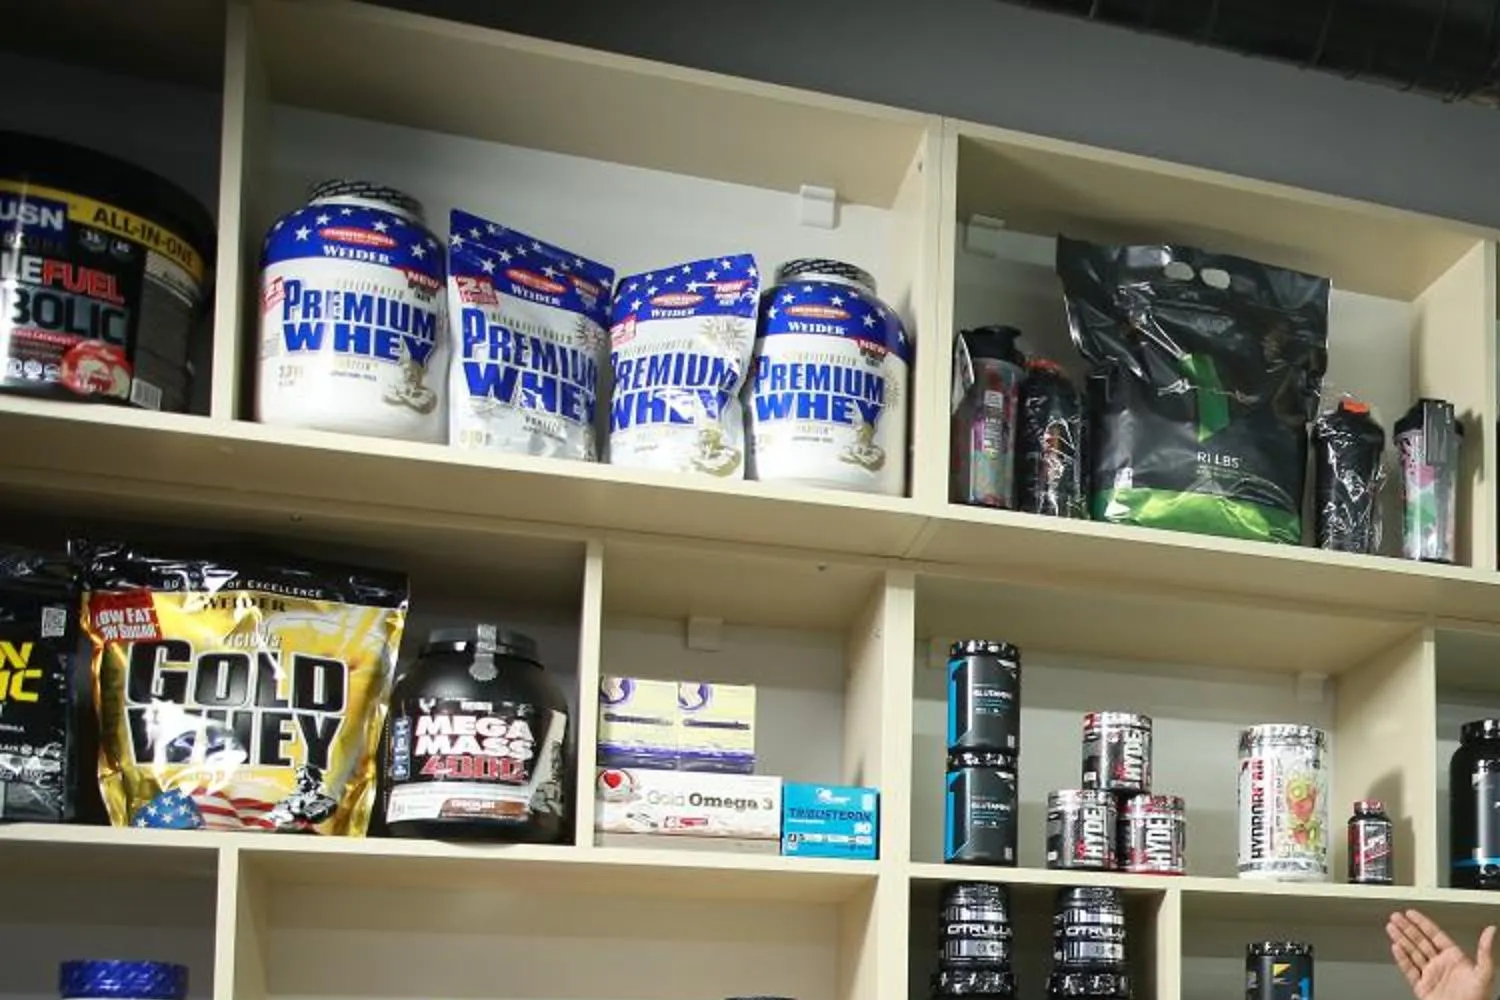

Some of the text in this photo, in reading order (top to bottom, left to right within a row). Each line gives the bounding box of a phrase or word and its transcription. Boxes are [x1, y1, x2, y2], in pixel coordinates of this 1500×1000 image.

[92, 206, 196, 269] ALL-IN-ONE
[322, 244, 391, 265] WEIDER
[282, 279, 437, 341] PREMIUM
[787, 321, 846, 336] WEIDER
[283, 321, 434, 366] WHEY
[755, 355, 885, 406] PREMIUM
[755, 391, 882, 427] WHEY
[247, 578, 322, 598] EXCELLENCE
[126, 606, 151, 624] FAT
[127, 639, 348, 713] GOLD
[415, 714, 535, 742] MEGA
[415, 735, 535, 761] MASS
[688, 791, 759, 812] Omega
[764, 797, 774, 811] 3
